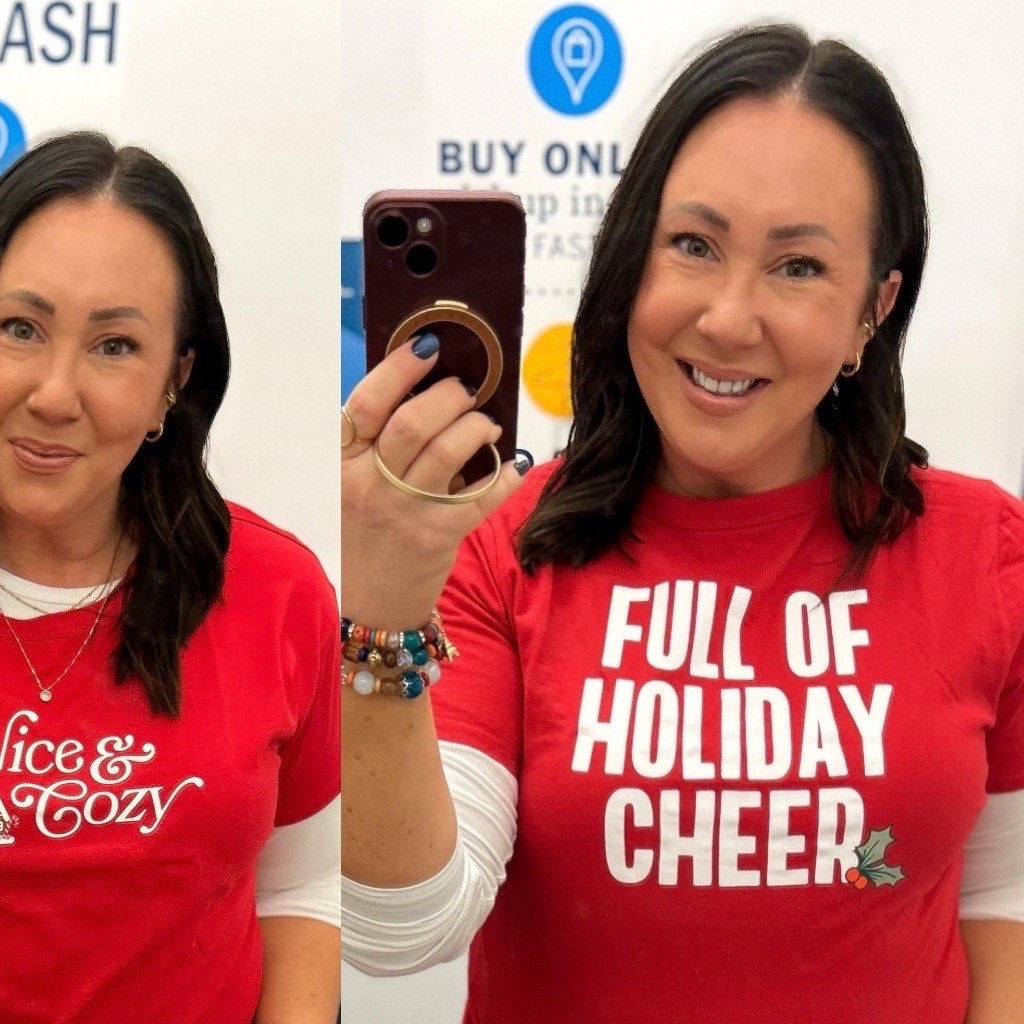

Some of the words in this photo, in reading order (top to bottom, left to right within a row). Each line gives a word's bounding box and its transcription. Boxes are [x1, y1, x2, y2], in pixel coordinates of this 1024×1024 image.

[439, 141, 525, 176] BUY
[544, 142, 626, 176] ONL
[601, 579, 755, 680] FULL
[785, 588, 870, 679] OF
[90, 734, 156, 785] &
[571, 677, 893, 781] HOLIDAY
[10, 776, 205, 839] Cozy
[604, 786, 865, 888] CHEER
